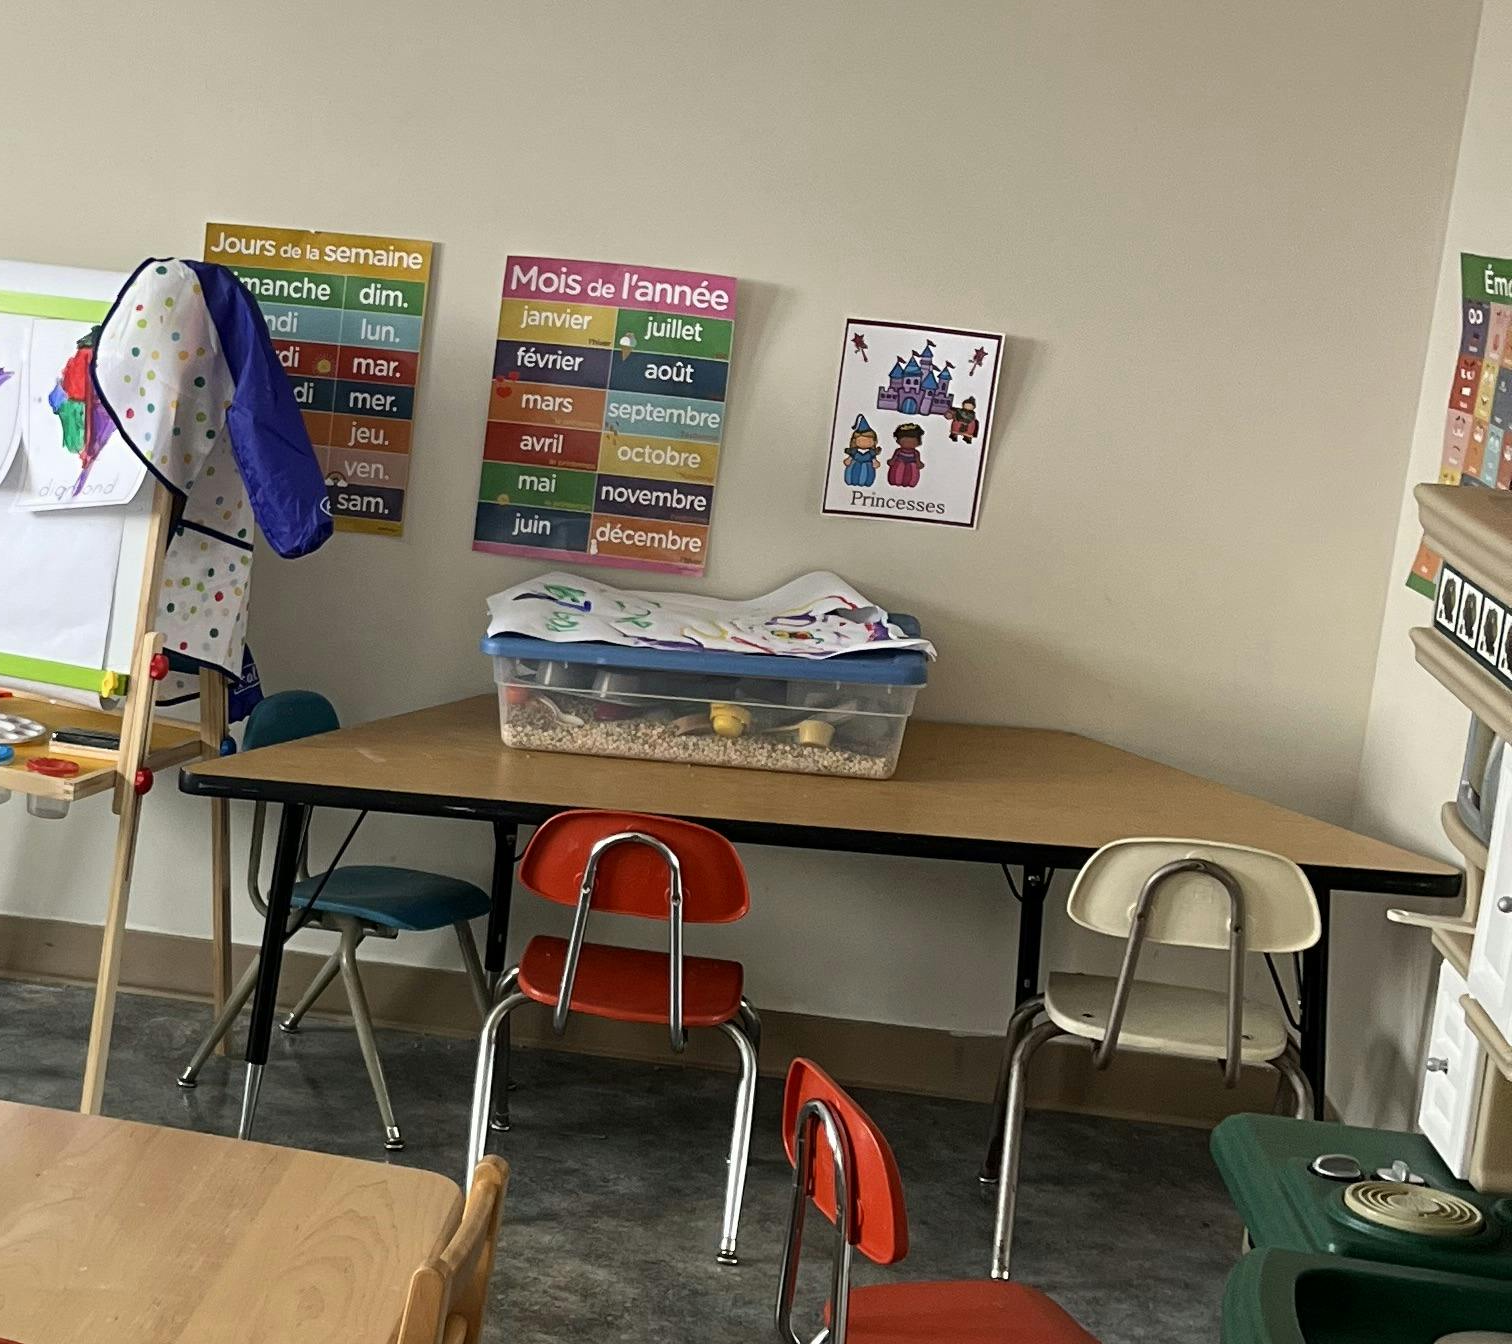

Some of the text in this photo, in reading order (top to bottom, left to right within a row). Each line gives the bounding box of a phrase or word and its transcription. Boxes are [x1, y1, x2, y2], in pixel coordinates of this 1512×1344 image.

[211, 233, 422, 269] Jours de la semaine
[233, 271, 330, 300] manche
[360, 283, 408, 307] dim.
[510, 264, 730, 310] Mois de l'année
[264, 311, 299, 333] ndi
[520, 306, 593, 330] janvier
[644, 316, 703, 342] juillet
[361, 319, 399, 342] lun.
[353, 358, 400, 377] mar.
[517, 346, 584, 372] février
[645, 362, 694, 382] août
[350, 392, 396, 411] mer.
[522, 394, 573, 412] mars
[608, 398, 720, 428] septembre
[348, 421, 389, 446] jeu.
[520, 434, 563, 453] avril
[617, 444, 701, 468] octobre
[344, 460, 389, 480] ven.
[519, 474, 556, 492] mai
[337, 494, 388, 514] sam.
[602, 486, 706, 510] novembre
[850, 491, 945, 515] Princesses
[512, 513, 550, 535] juin
[596, 523, 702, 553] décembre
